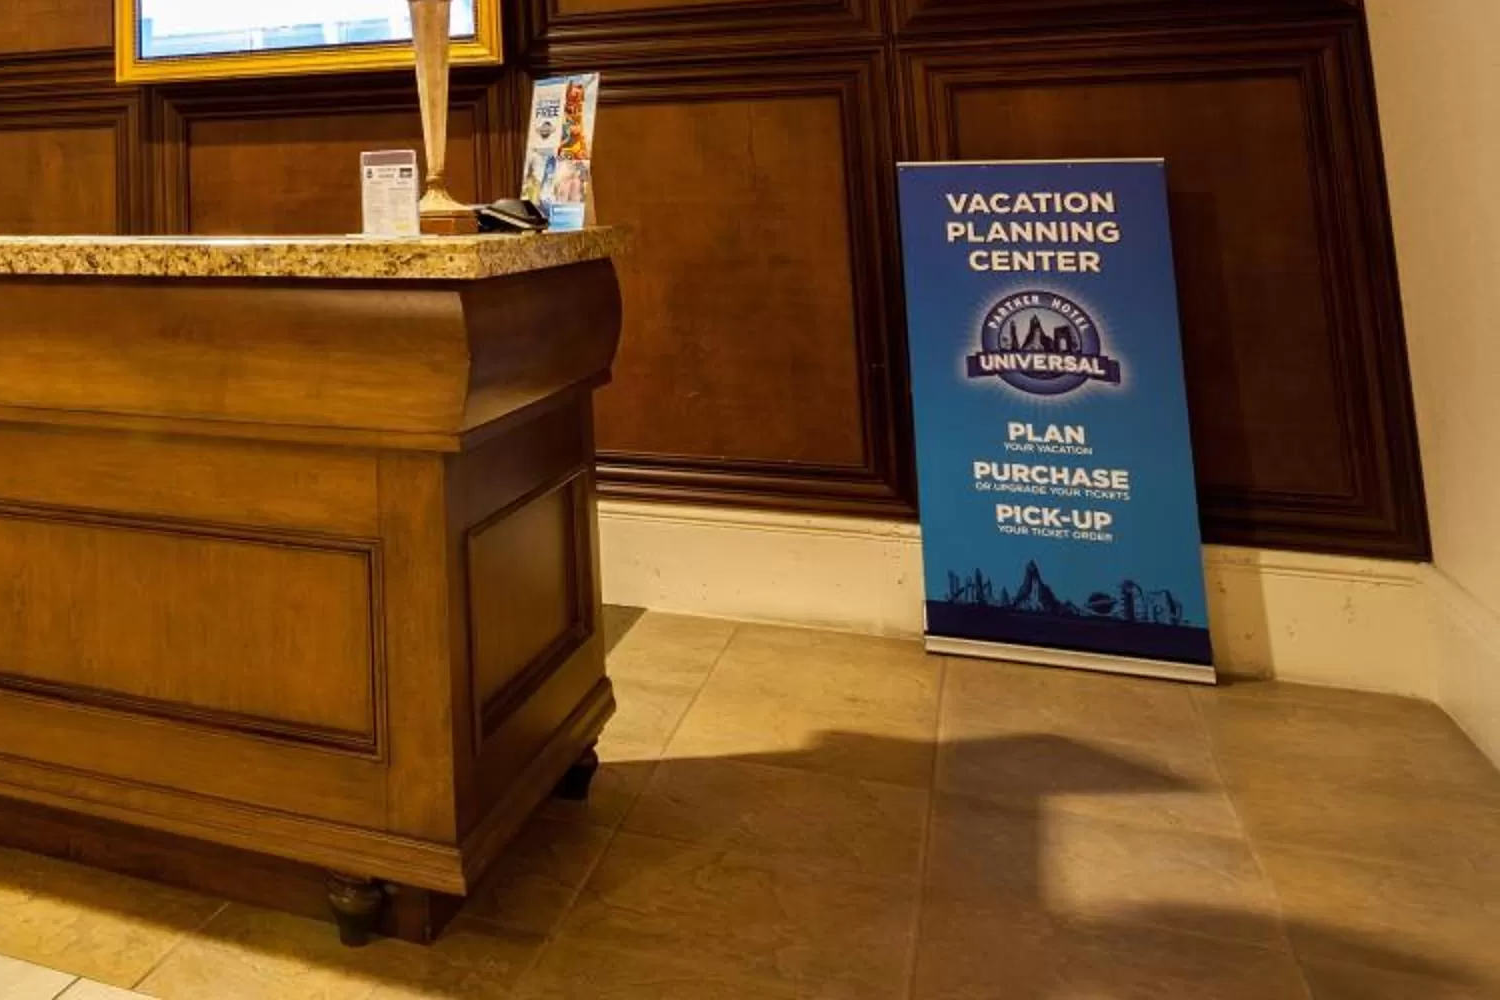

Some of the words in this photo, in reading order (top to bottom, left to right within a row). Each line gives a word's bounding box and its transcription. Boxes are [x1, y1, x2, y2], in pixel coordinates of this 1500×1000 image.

[946, 192, 1116, 213] VACATION
[947, 221, 1120, 243] PLANNING
[969, 250, 1101, 272] CENTER
[988, 295, 1040, 329] PARTNER
[1051, 297, 1090, 329] HOTEL
[980, 353, 1107, 375] UNIVERSAL
[1007, 421, 1085, 445] PLAN
[1004, 442, 1034, 452] YOUR
[1037, 443, 1093, 455] VACATION
[973, 461, 1129, 489] PURCHASE
[992, 483, 1047, 495] UPGRADE
[1050, 487, 1082, 497] YOUR
[1085, 489, 1131, 501] TICKETS
[995, 503, 1113, 530] PICK-UP
[998, 525, 1029, 535] YOUR
[1032, 527, 1070, 538] TICKET
[1072, 530, 1113, 542] ORDER
